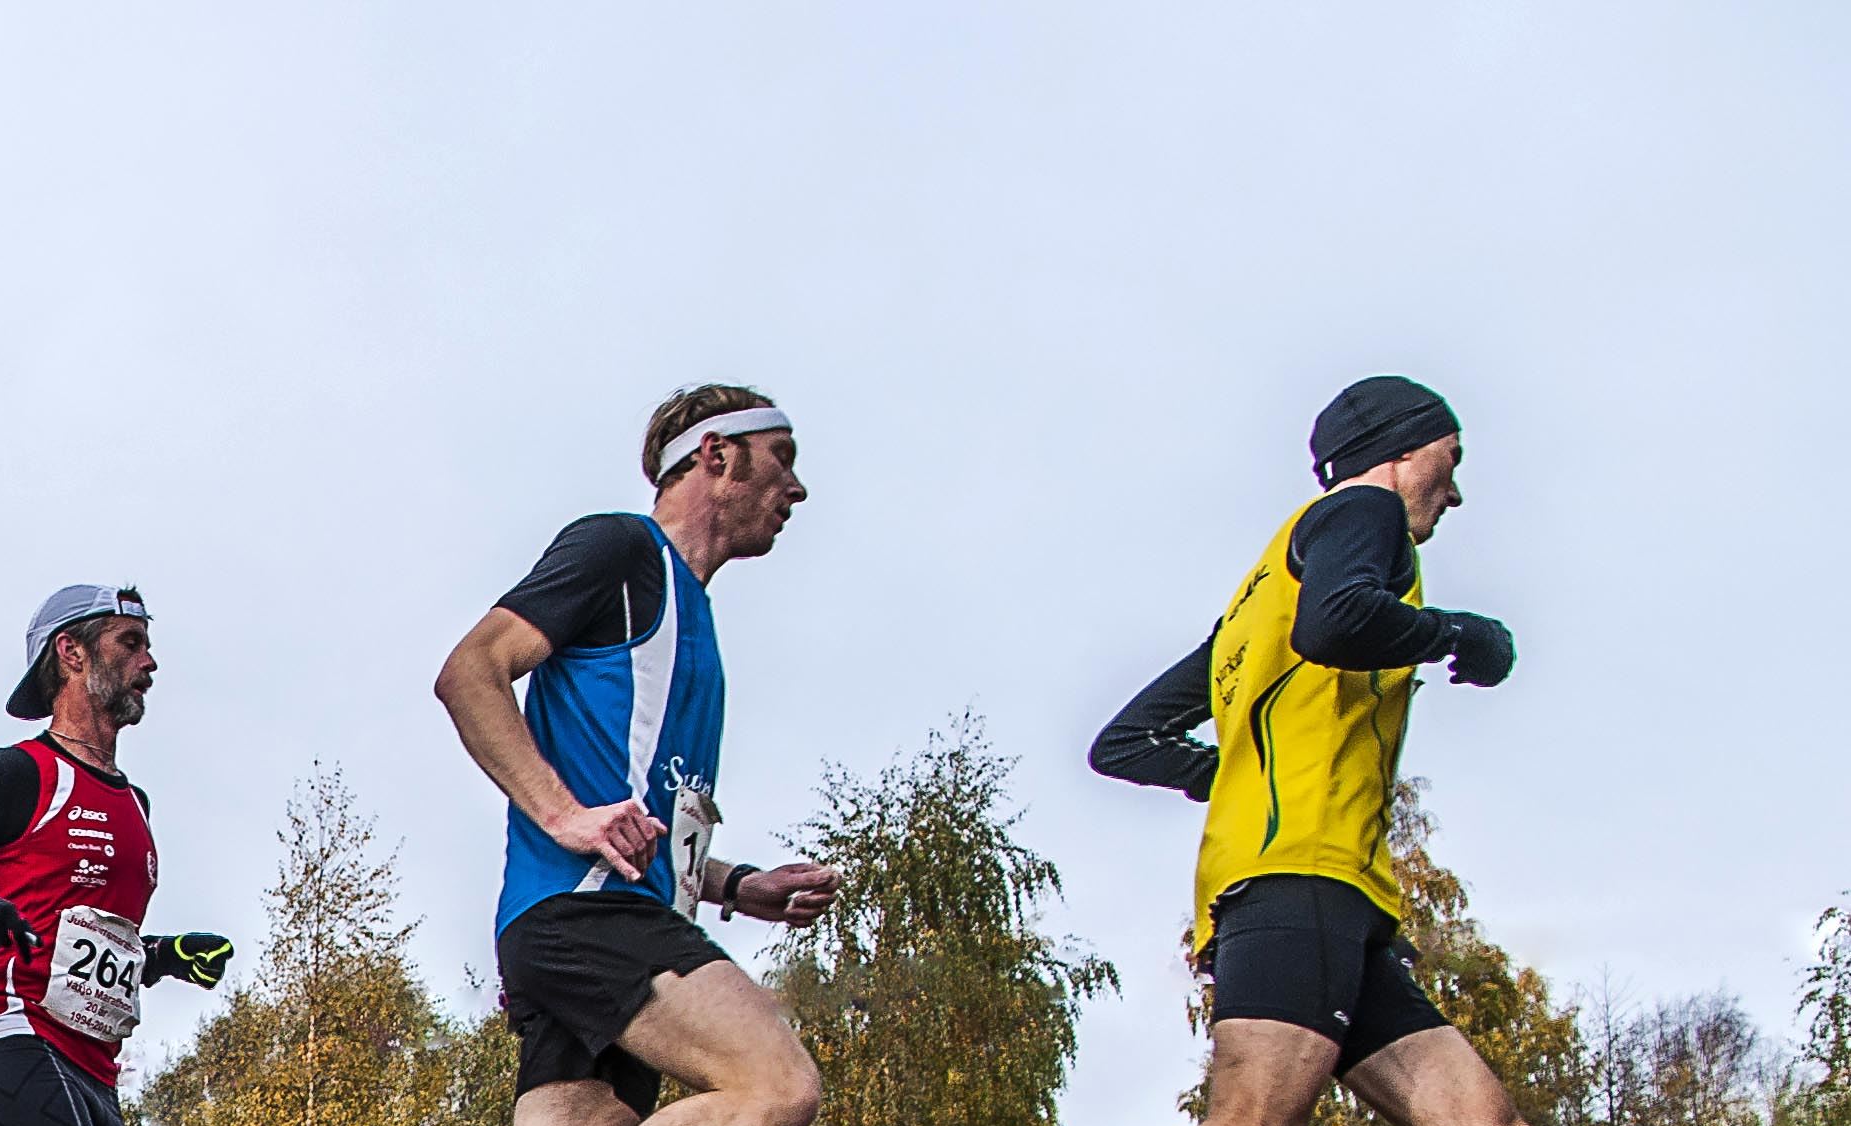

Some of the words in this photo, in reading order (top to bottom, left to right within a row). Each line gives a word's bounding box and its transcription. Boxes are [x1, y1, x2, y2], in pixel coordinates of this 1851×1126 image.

[68, 938, 135, 999] 264
[84, 1001, 99, 1014] 20
[94, 988, 133, 1014] Marathon
[70, 1011, 113, 1034] 1994-2013
